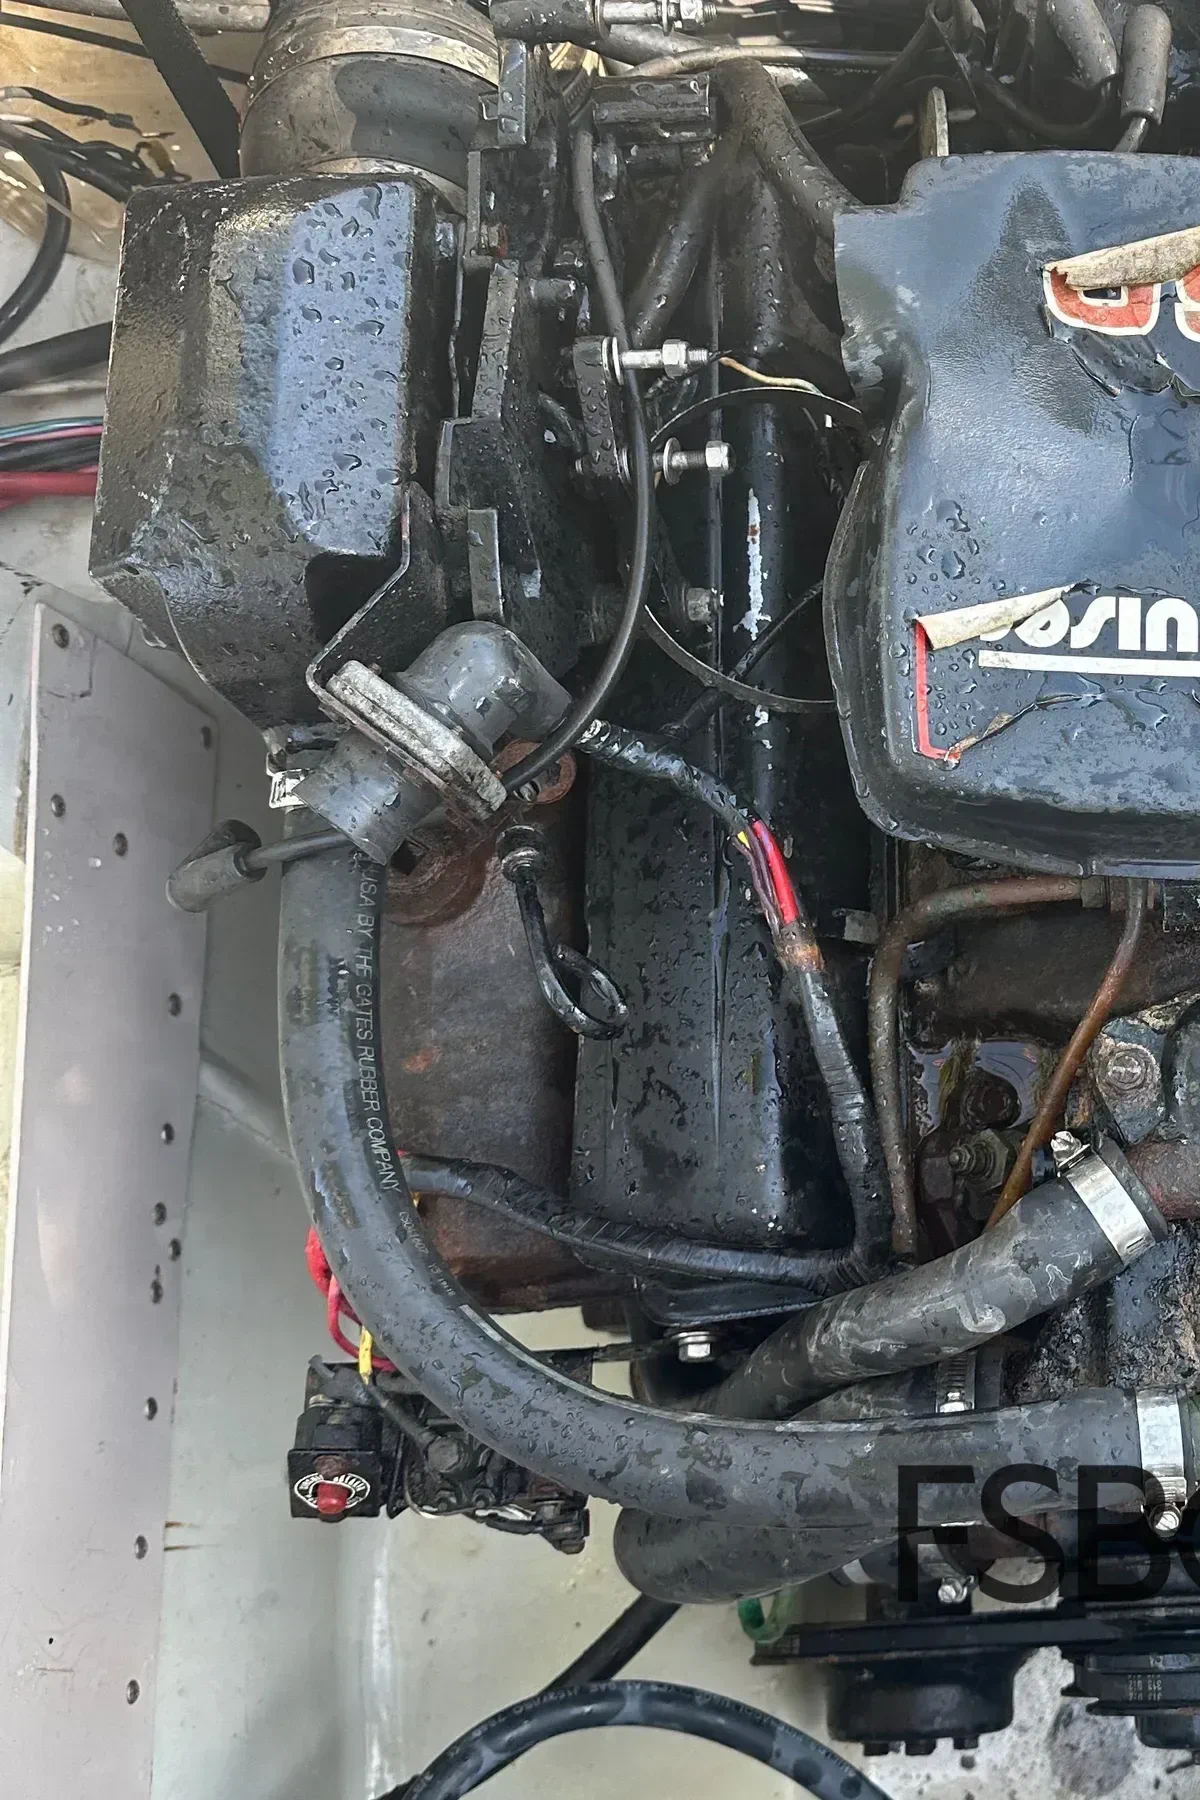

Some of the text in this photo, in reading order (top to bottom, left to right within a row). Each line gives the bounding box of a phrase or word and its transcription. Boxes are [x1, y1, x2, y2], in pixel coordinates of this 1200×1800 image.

[356, 914, 374, 938] BY
[354, 945, 374, 979] THE
[354, 983, 374, 1041] GATES
[356, 1045, 380, 1111] RUBBER
[366, 1116, 402, 1194] COMPANY
